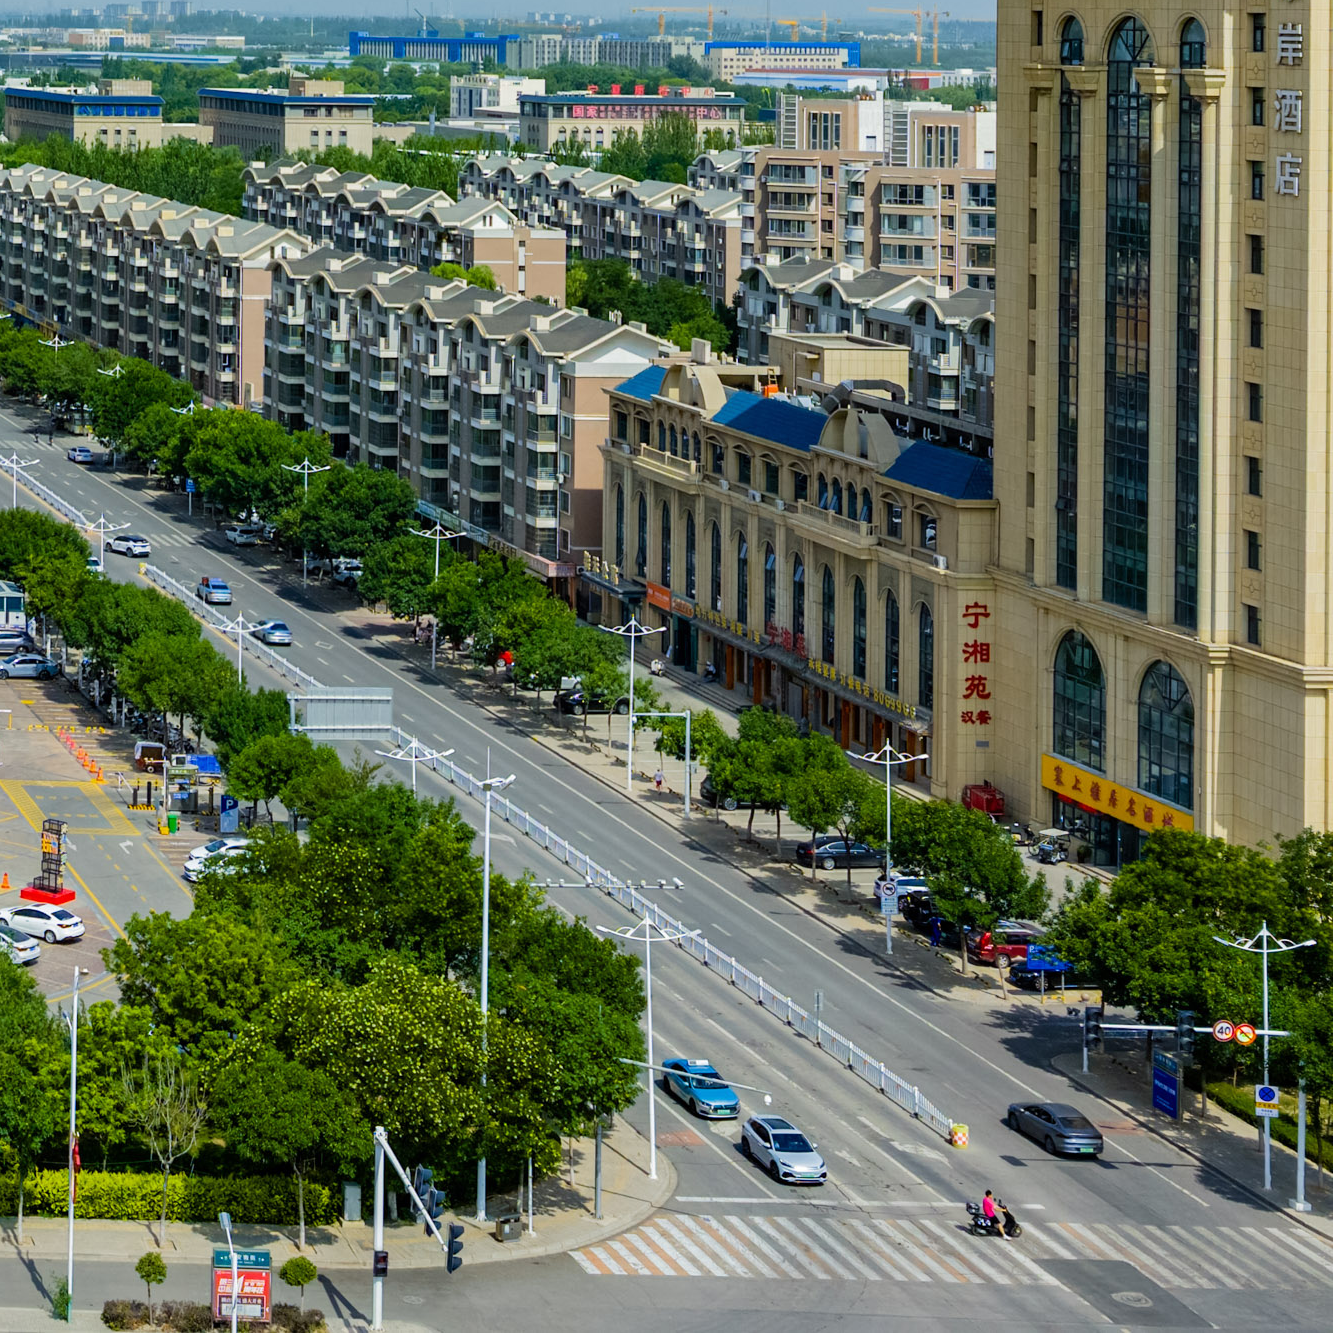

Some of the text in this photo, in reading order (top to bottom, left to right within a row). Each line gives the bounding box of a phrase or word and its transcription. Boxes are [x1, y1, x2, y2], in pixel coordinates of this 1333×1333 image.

[962, 601, 991, 700] 宁湘苑
[961, 710, 992, 725] 汉餐
[226, 799, 234, 809] P
[1217, 1026, 1231, 1036] 40
